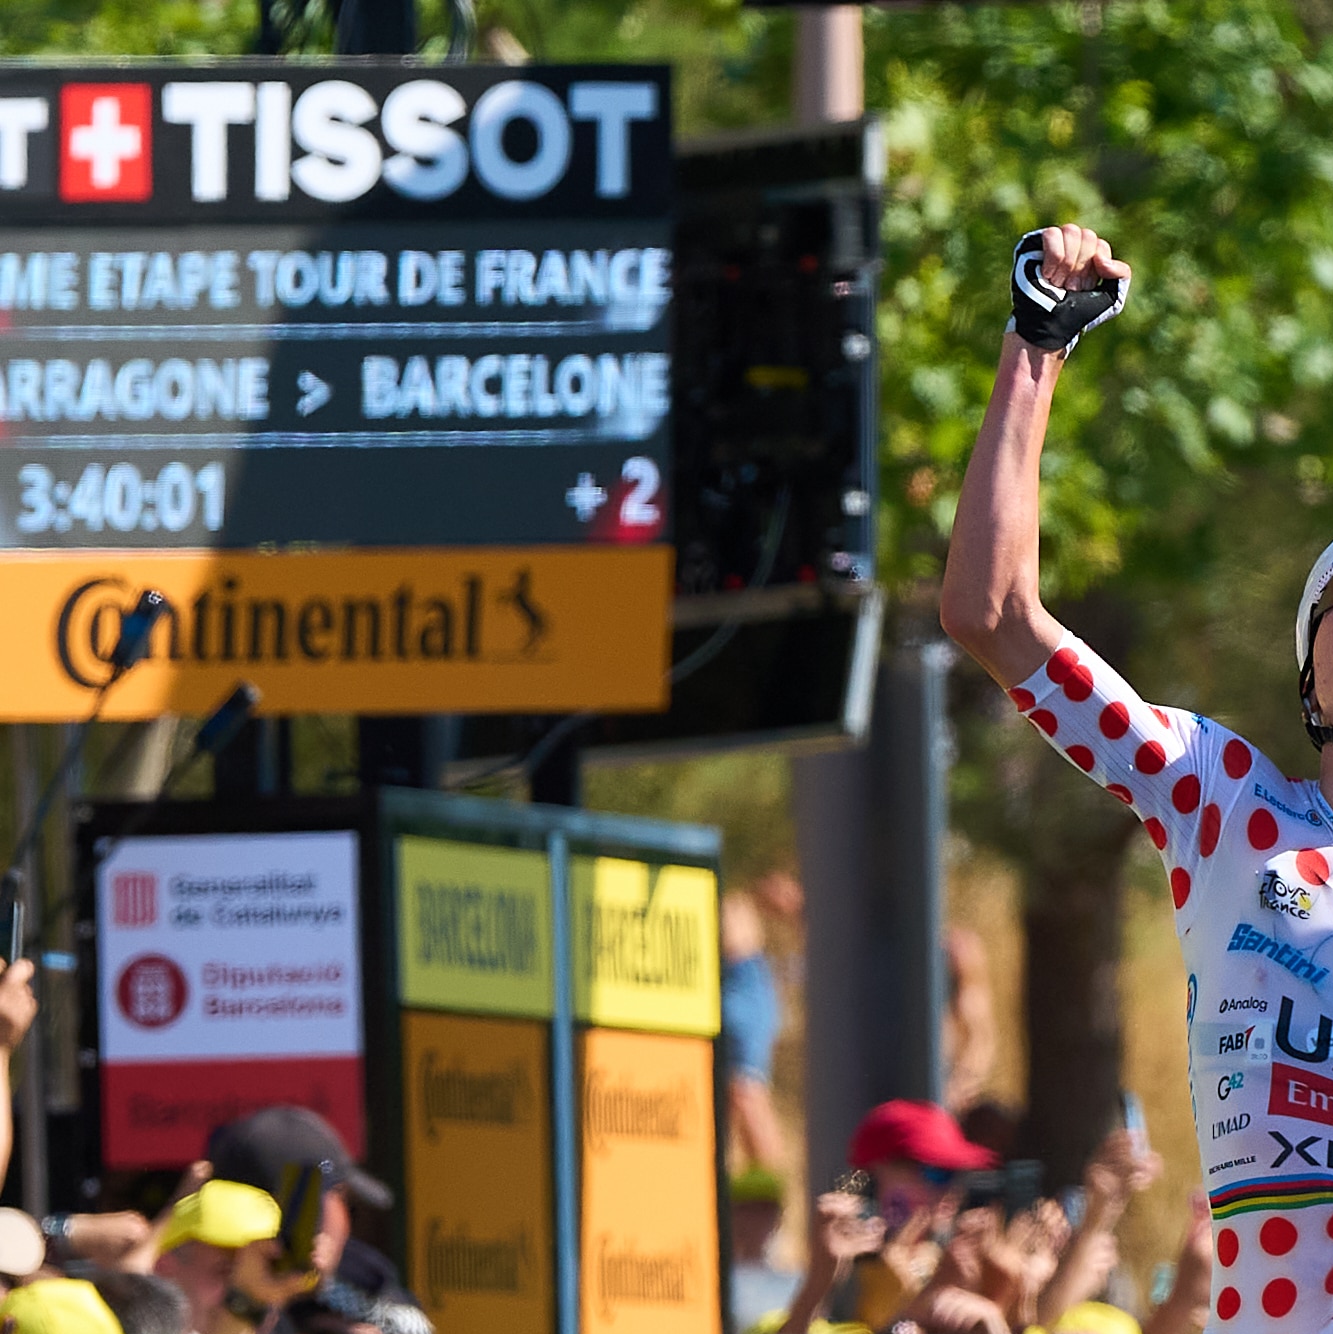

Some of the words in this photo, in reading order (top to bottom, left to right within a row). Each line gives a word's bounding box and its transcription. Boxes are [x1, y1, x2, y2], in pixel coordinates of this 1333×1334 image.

[162, 79, 659, 202] TISSOT
[88, 250, 243, 311] ETAPE
[248, 248, 388, 308] TOUR
[400, 248, 466, 305] DE
[475, 246, 672, 307] FRANCE
[0, 358, 270, 422] RRAGONE
[361, 354, 670, 419] BARCELONE
[16, 462, 226, 532] 3:40:01
[55, 573, 486, 690] Continental
[1227, 922, 1331, 985] Santini
[1228, 996, 1268, 1013] Analog
[1217, 1071, 1245, 1101] G42
[1234, 1155, 1257, 1168] MILLE
